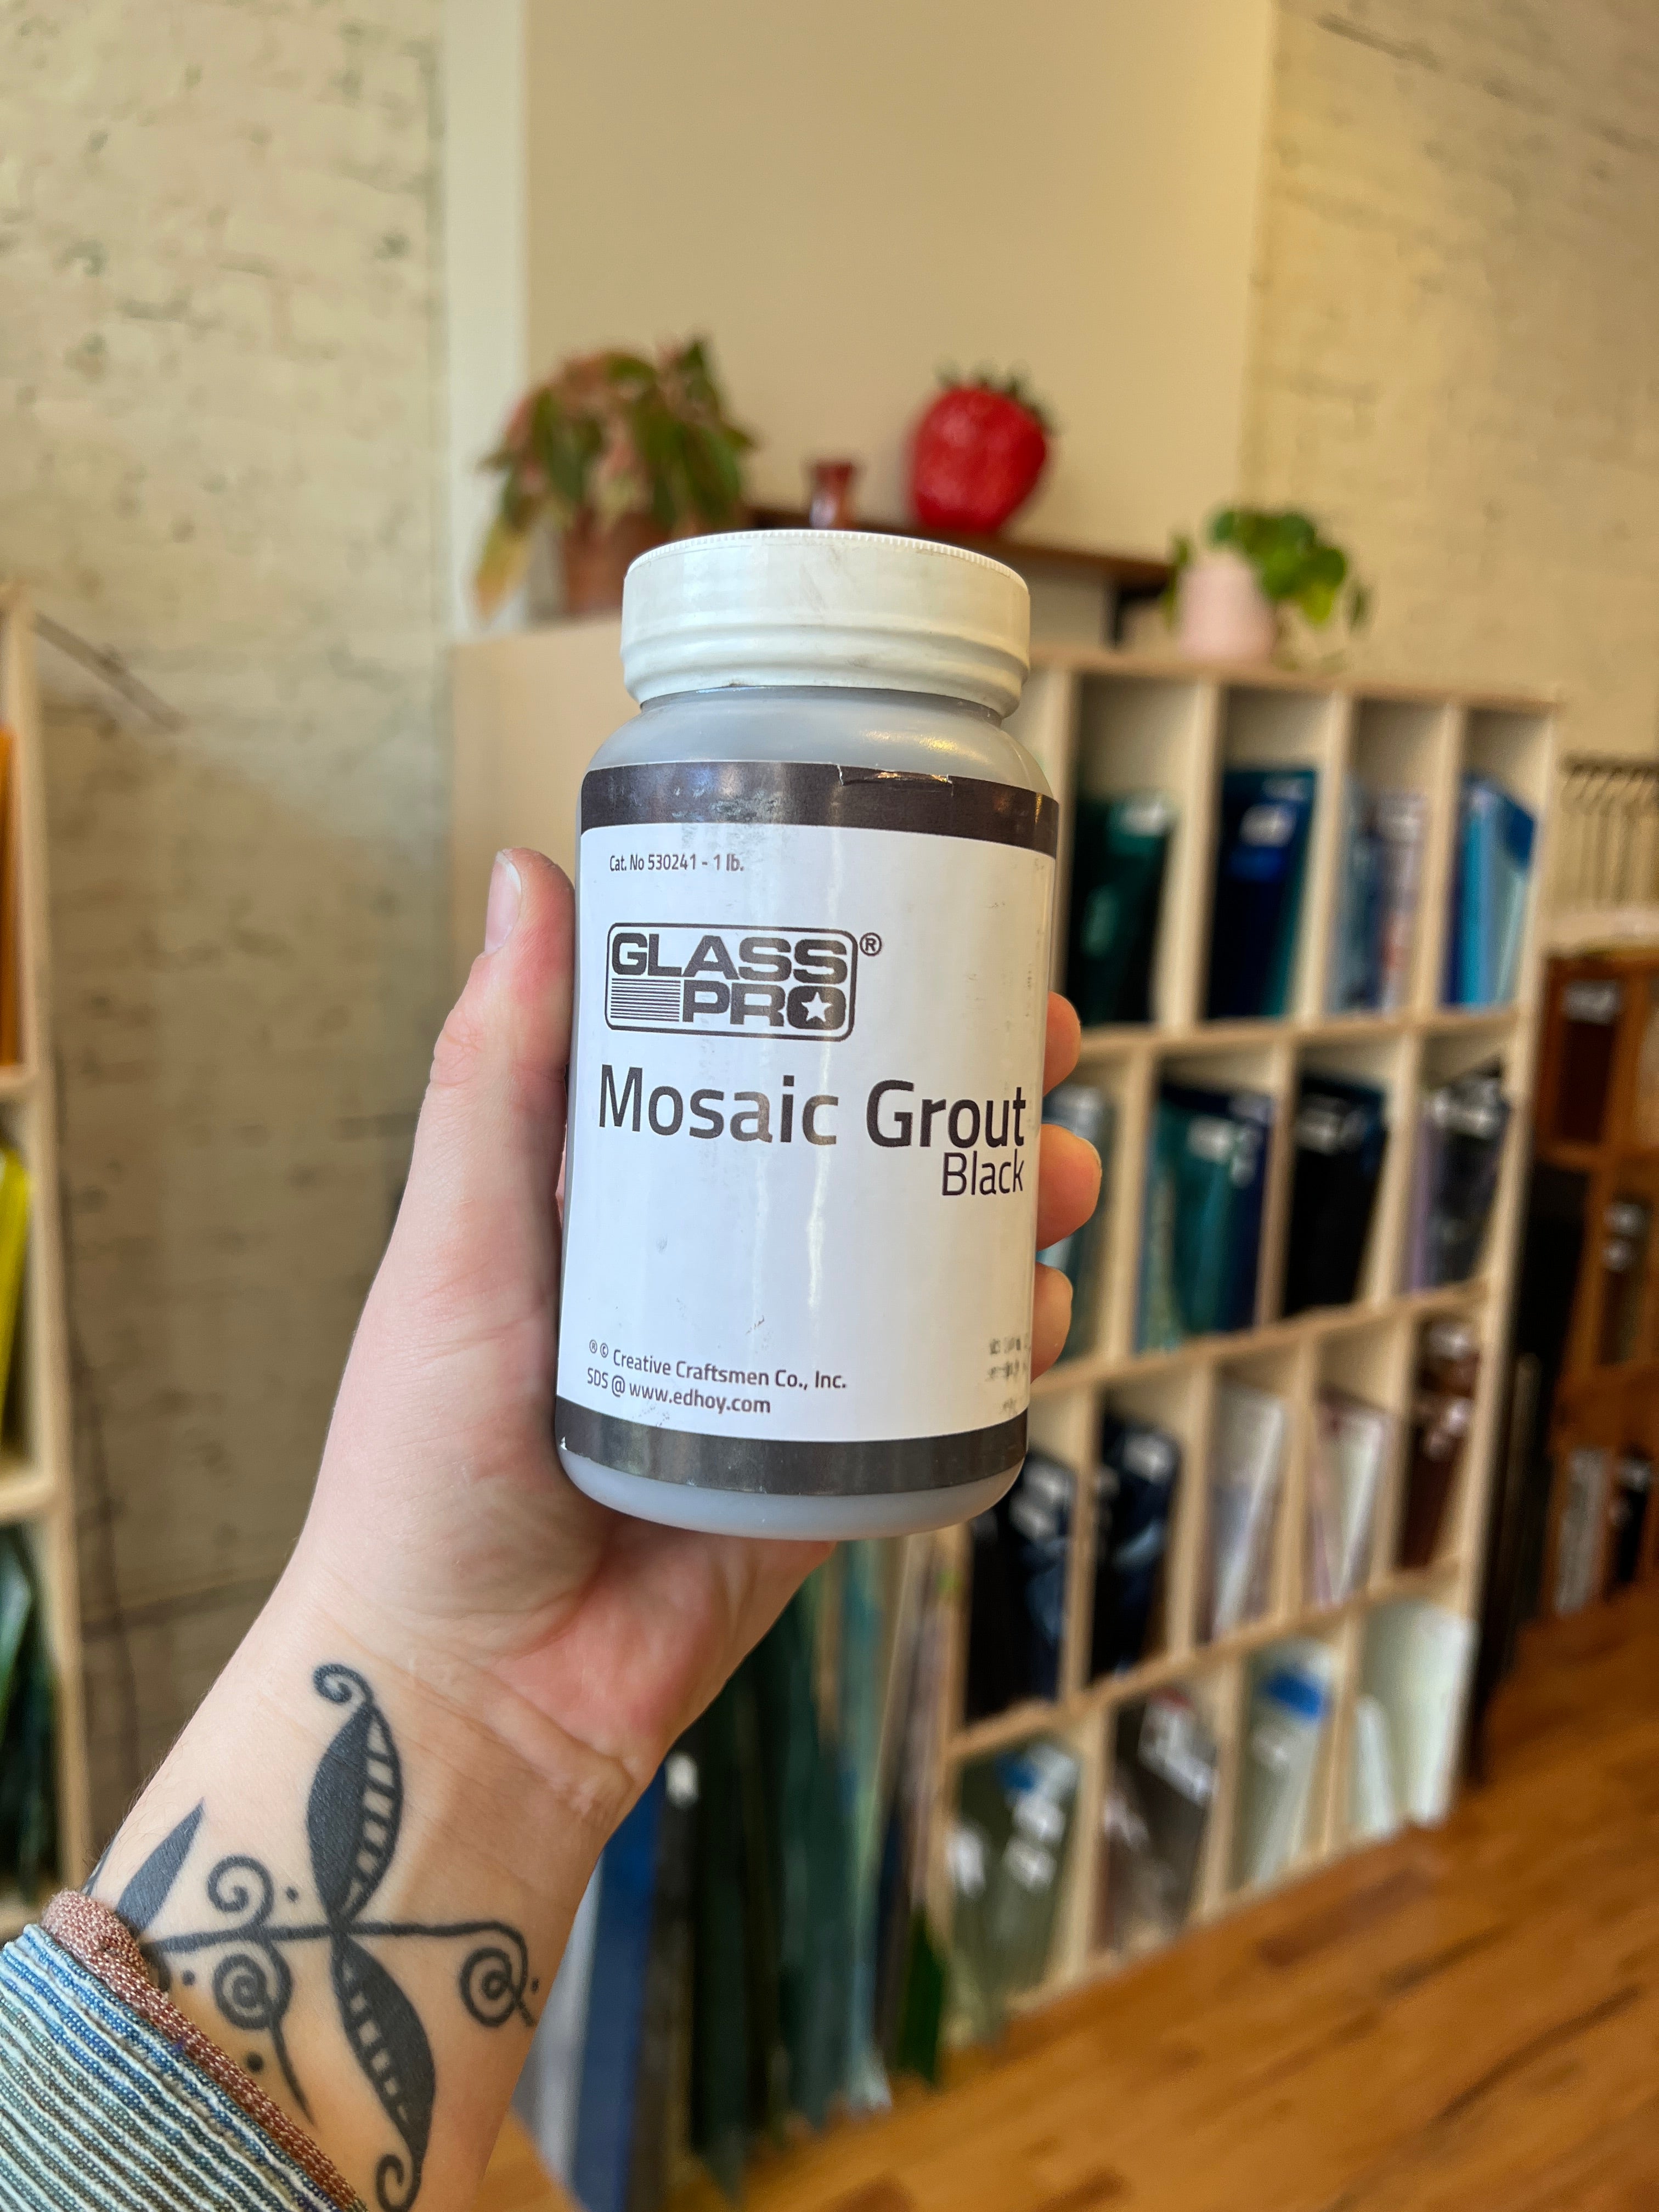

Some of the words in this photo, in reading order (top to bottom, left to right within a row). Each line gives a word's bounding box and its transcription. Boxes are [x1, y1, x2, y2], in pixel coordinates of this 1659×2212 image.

[610, 854, 627, 871] Cat.
[630, 854, 644, 871] No
[648, 853, 696, 871] 530241
[713, 853, 720, 871] 1
[726, 853, 744, 871] lb.
[611, 932, 847, 984] GLASS
[682, 980, 846, 1030] PRO
[599, 1064, 839, 1146] Mosaic
[866, 1079, 1027, 1149] Grout
[941, 1149, 1025, 1196] Black
[587, 1367, 608, 1390] SDS
[612, 1375, 625, 1397] @
[629, 1381, 771, 1414] www.edhoy.com
[613, 1349, 671, 1376] Creative
[676, 1360, 769, 1386] Craftsmen
[775, 1369, 808, 1391] Co.,
[815, 1370, 847, 1389] Inc.
